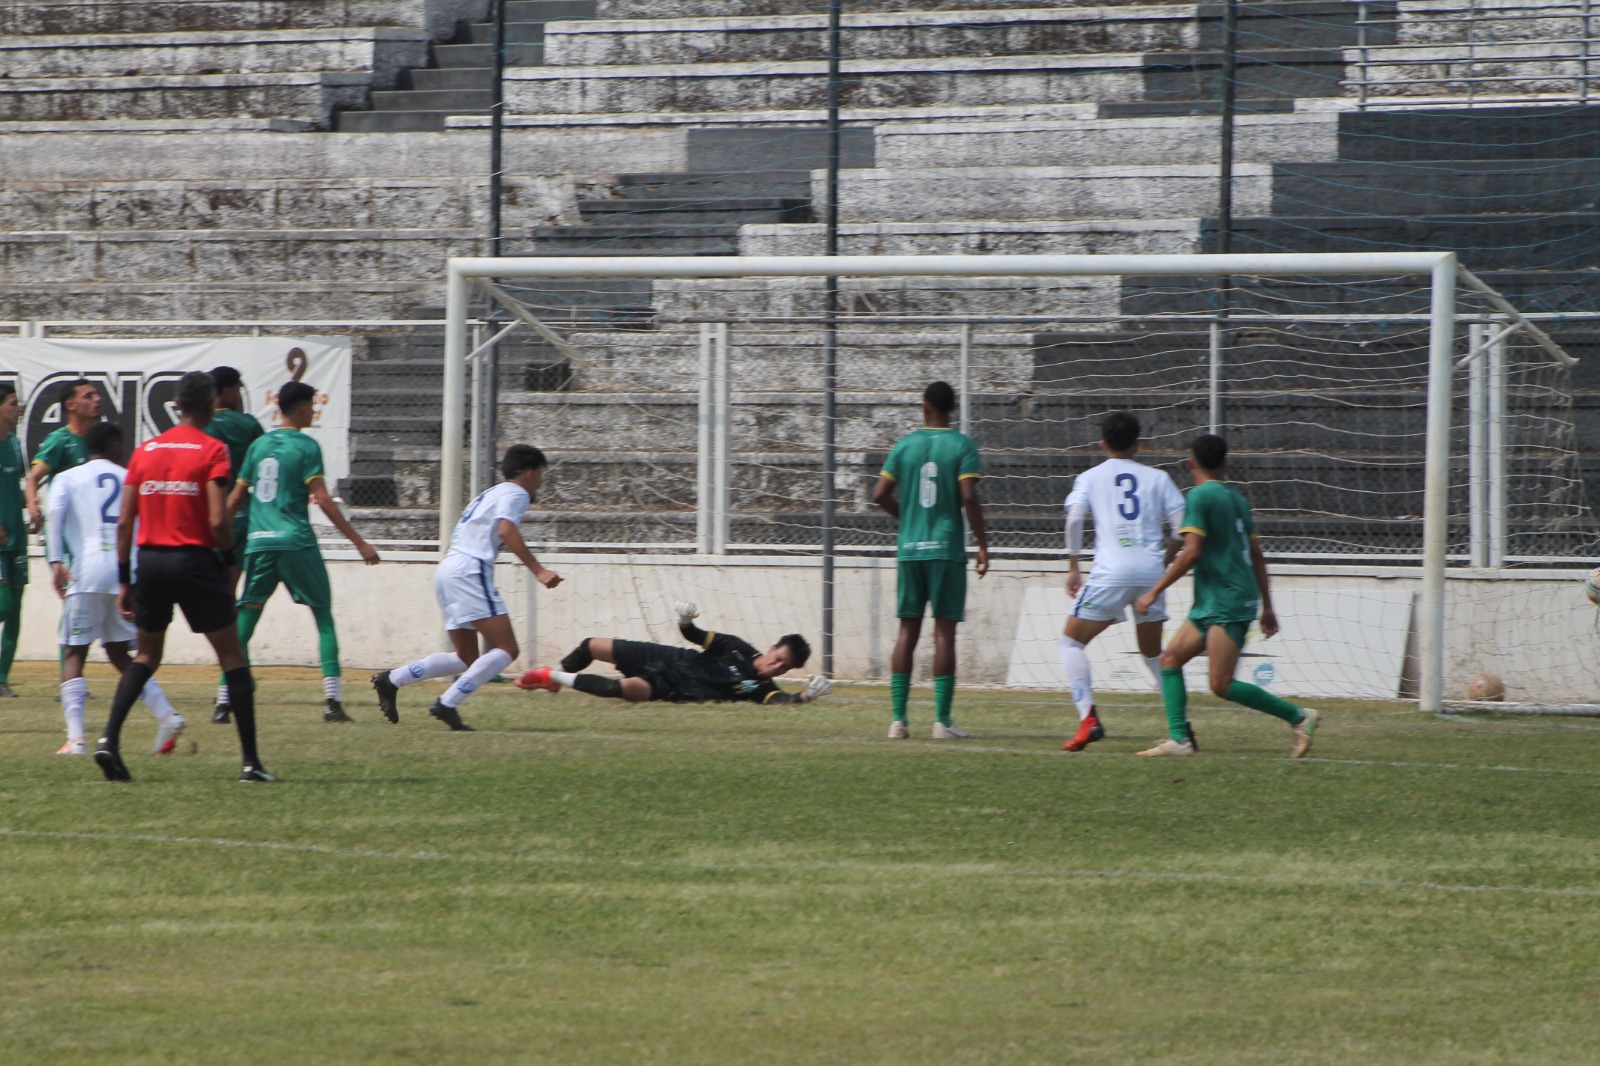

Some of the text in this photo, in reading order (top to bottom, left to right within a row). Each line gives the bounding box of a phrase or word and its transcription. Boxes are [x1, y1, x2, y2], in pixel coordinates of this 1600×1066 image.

[97, 472, 121, 524] 2
[255, 457, 279, 503] 8
[919, 461, 938, 508] 6
[1115, 472, 1140, 521] 3
